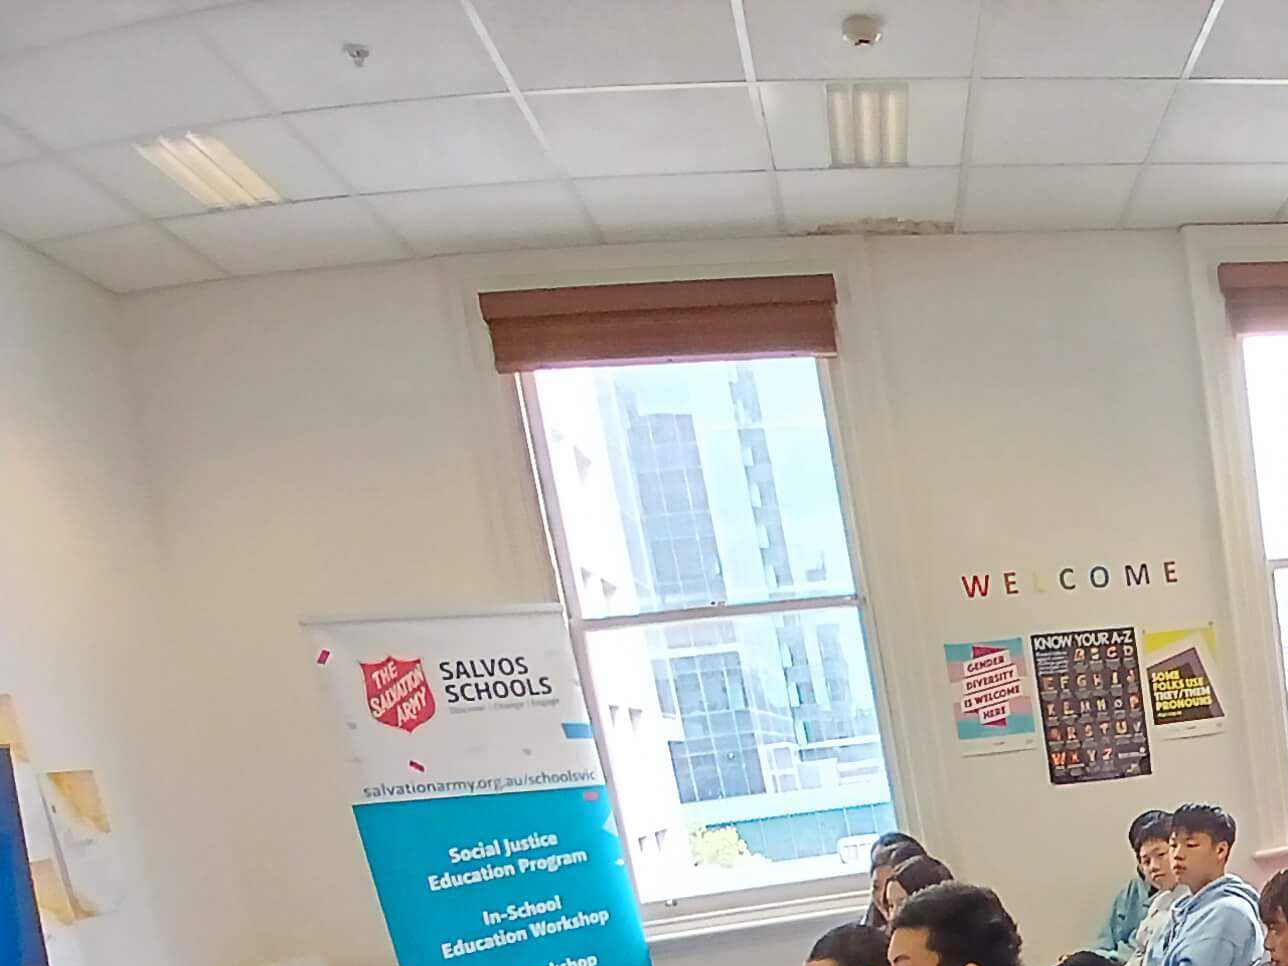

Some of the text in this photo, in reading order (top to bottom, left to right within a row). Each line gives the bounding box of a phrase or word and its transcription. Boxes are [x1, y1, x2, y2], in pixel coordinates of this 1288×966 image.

[962, 561, 1178, 598] WELCOME
[1034, 630, 1133, 650] KNOW YOUR A-Z
[1123, 645, 1133, 656] D
[371, 660, 398, 689] THE
[440, 656, 529, 681] SALVOS
[967, 656, 1004, 672] GENDER
[370, 663, 424, 718] SALVATION
[444, 677, 553, 703] SCHOOLS
[966, 670, 1014, 690] DIVERSITY
[975, 685, 1020, 704] WELCOME
[397, 686, 426, 727] ARMY
[983, 706, 1005, 719] HERE
[363, 769, 597, 798] salvationarmy.org.au/schoolsvic
[448, 833, 558, 863] Social Justice
[428, 850, 588, 891] Education Program
[483, 895, 562, 925] In-School
[441, 909, 609, 959] Education Workshop
